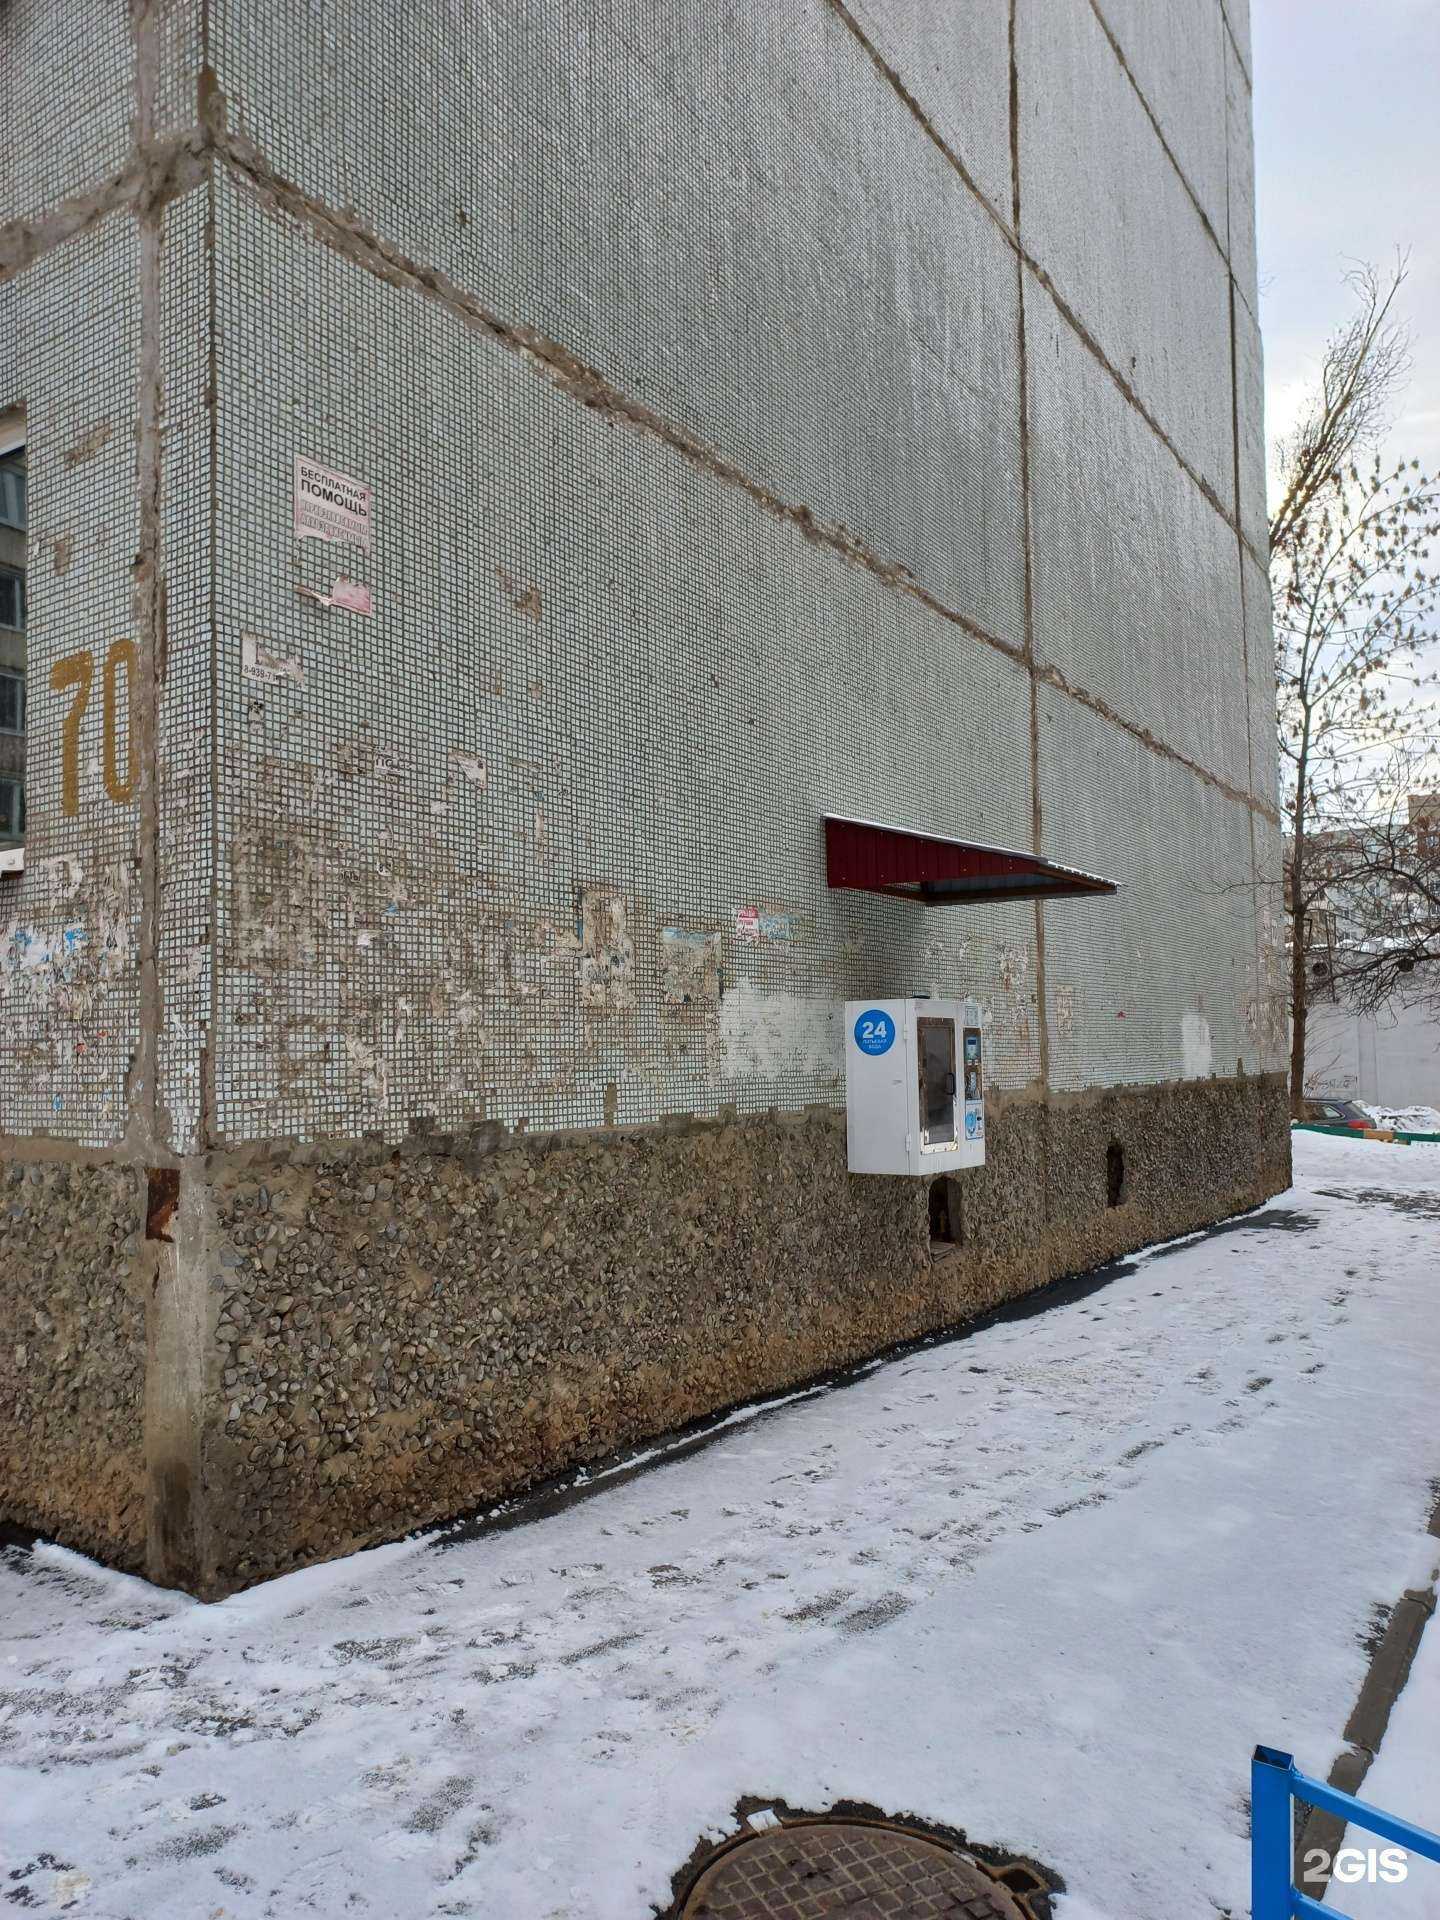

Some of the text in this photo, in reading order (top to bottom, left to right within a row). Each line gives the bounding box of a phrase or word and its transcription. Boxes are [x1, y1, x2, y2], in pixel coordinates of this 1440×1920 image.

[300, 466, 367, 502] БЕСПЛАТНАЯ
[301, 479, 368, 517] ПОМОЩЬ
[49, 638, 139, 817] 70
[862, 1021, 887, 1038] 24
